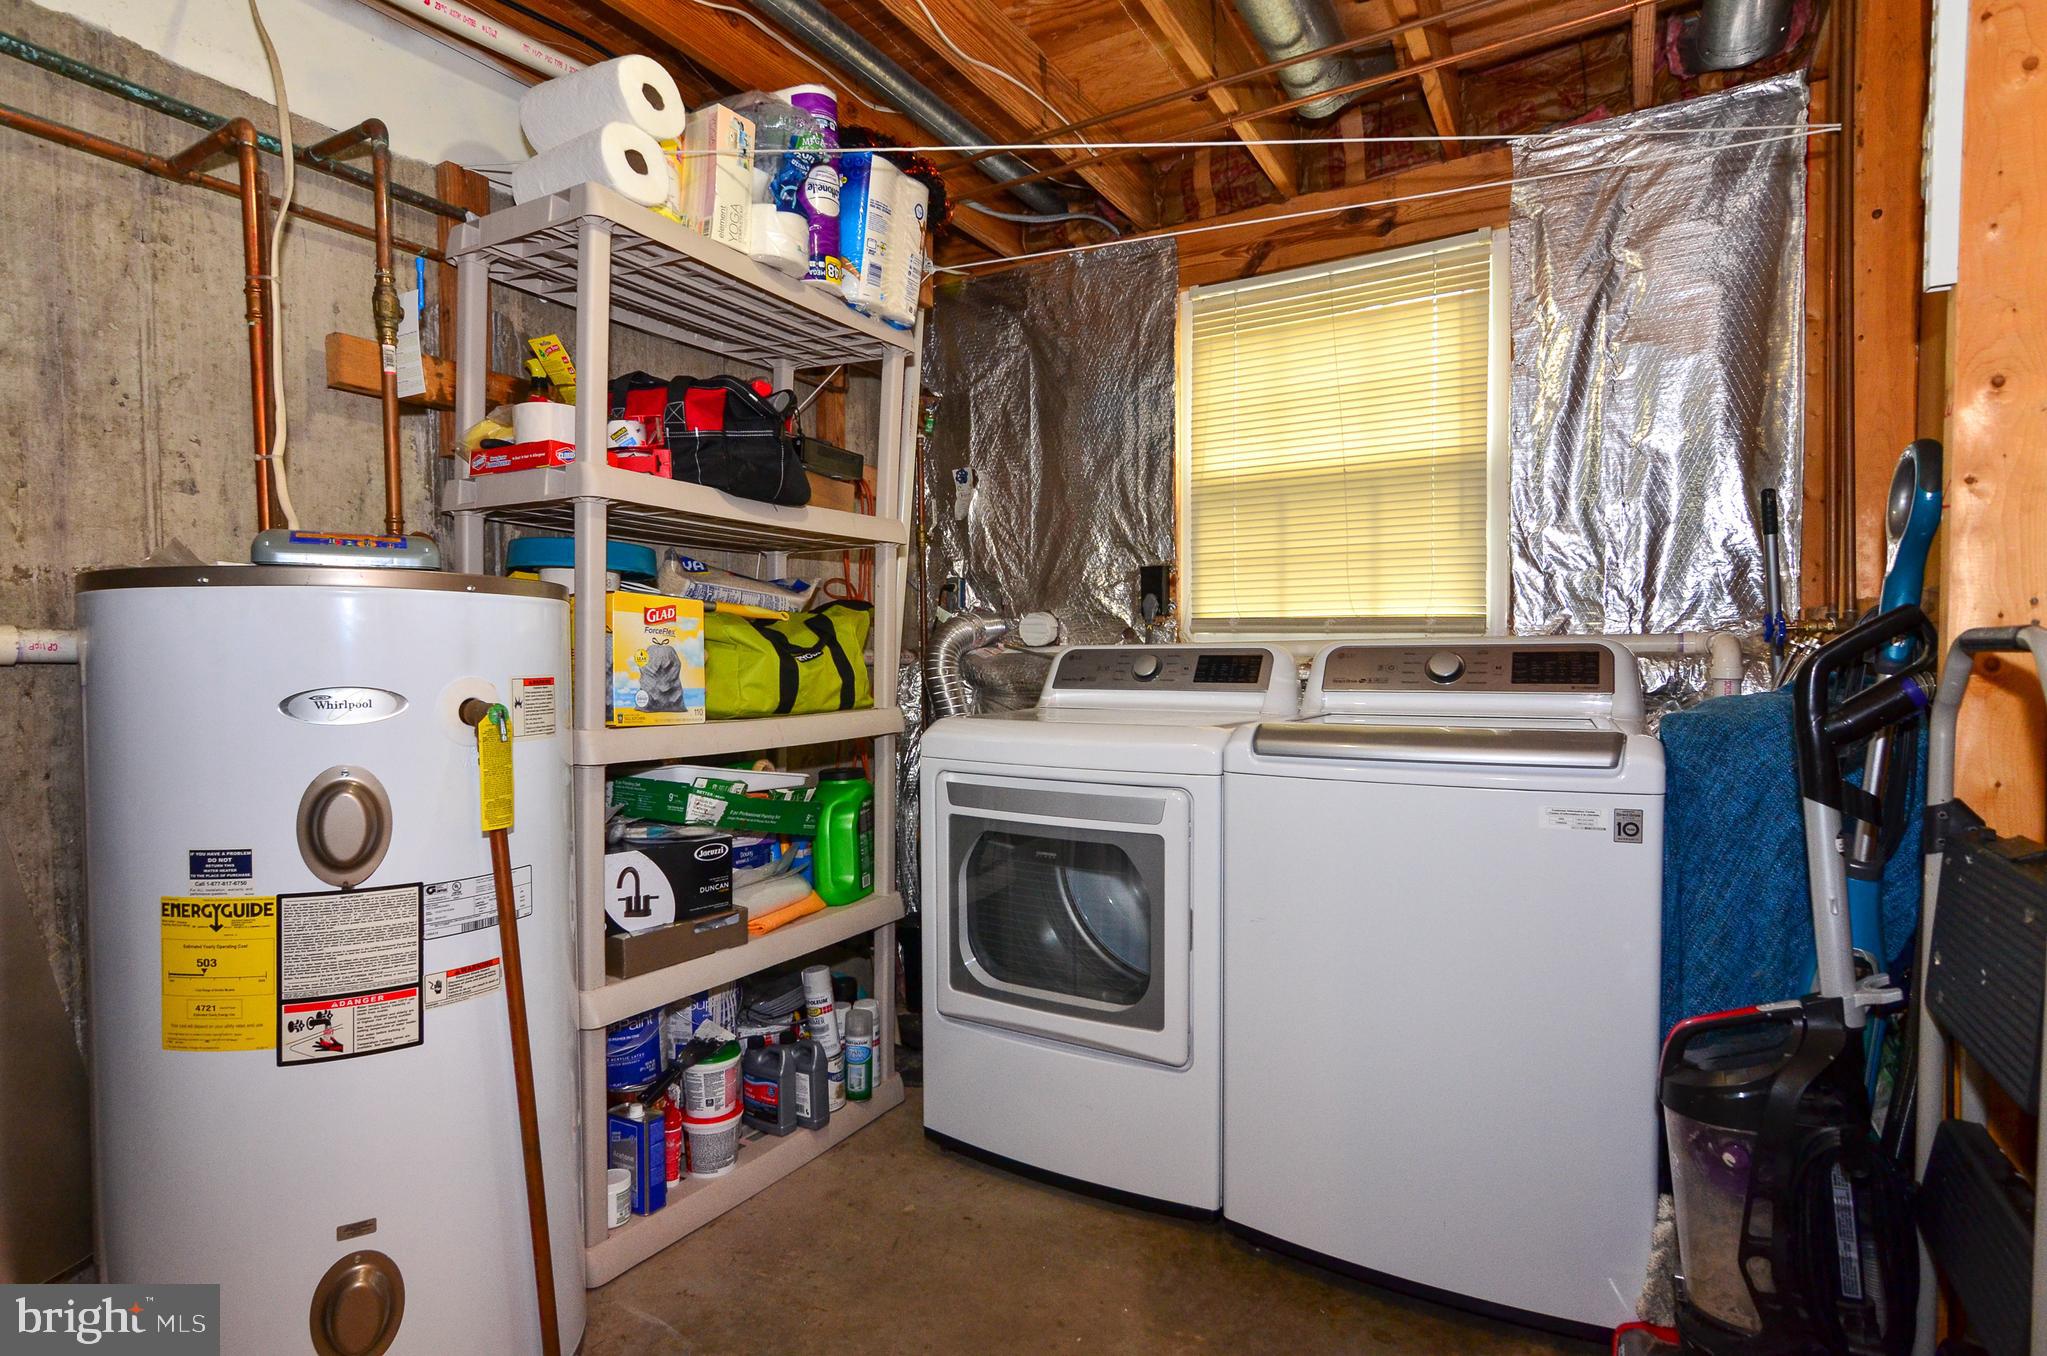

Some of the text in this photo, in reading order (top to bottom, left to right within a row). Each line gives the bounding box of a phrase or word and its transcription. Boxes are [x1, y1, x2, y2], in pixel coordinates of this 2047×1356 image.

[718, 205, 727, 239] element
[728, 204, 741, 242] YOGA
[646, 607, 675, 623] GLAD
[644, 626, 675, 635] ForceFlex
[314, 698, 373, 712] Whirlpool
[1617, 822, 1640, 837] 10
[700, 882, 729, 893] DUNCAN
[161, 902, 274, 920] ENERGYGUIDE
[196, 958, 217, 968] 503
[195, 1004, 216, 1012] 4721
[339, 995, 385, 1007] DANGER
